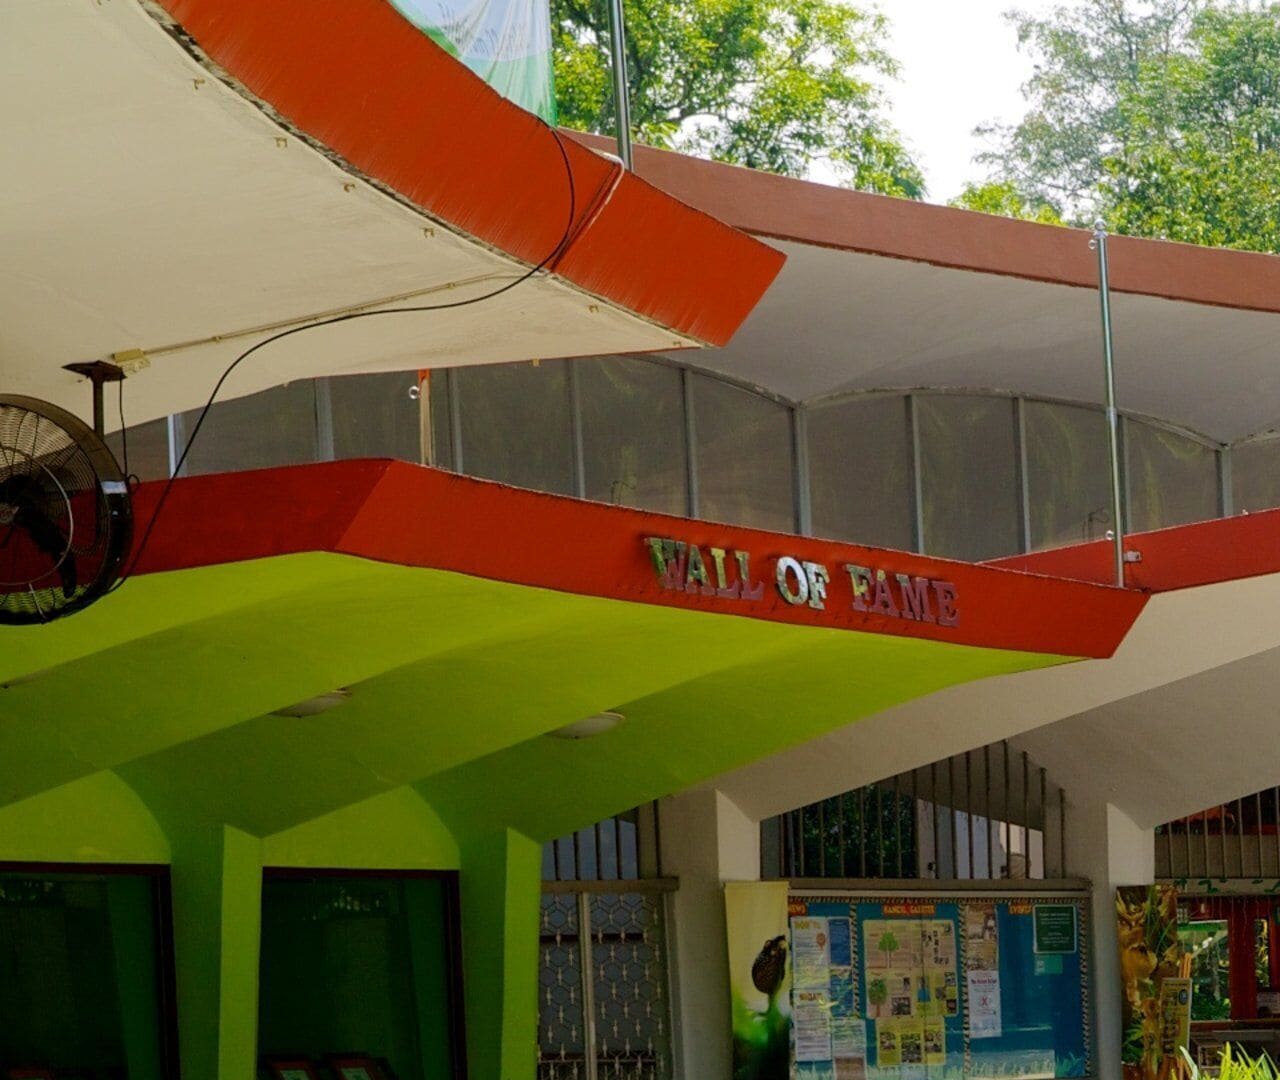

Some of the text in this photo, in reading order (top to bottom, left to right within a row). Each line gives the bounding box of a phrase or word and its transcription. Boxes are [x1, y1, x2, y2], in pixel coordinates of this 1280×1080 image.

[644, 537, 960, 627] WALL OF FAME
